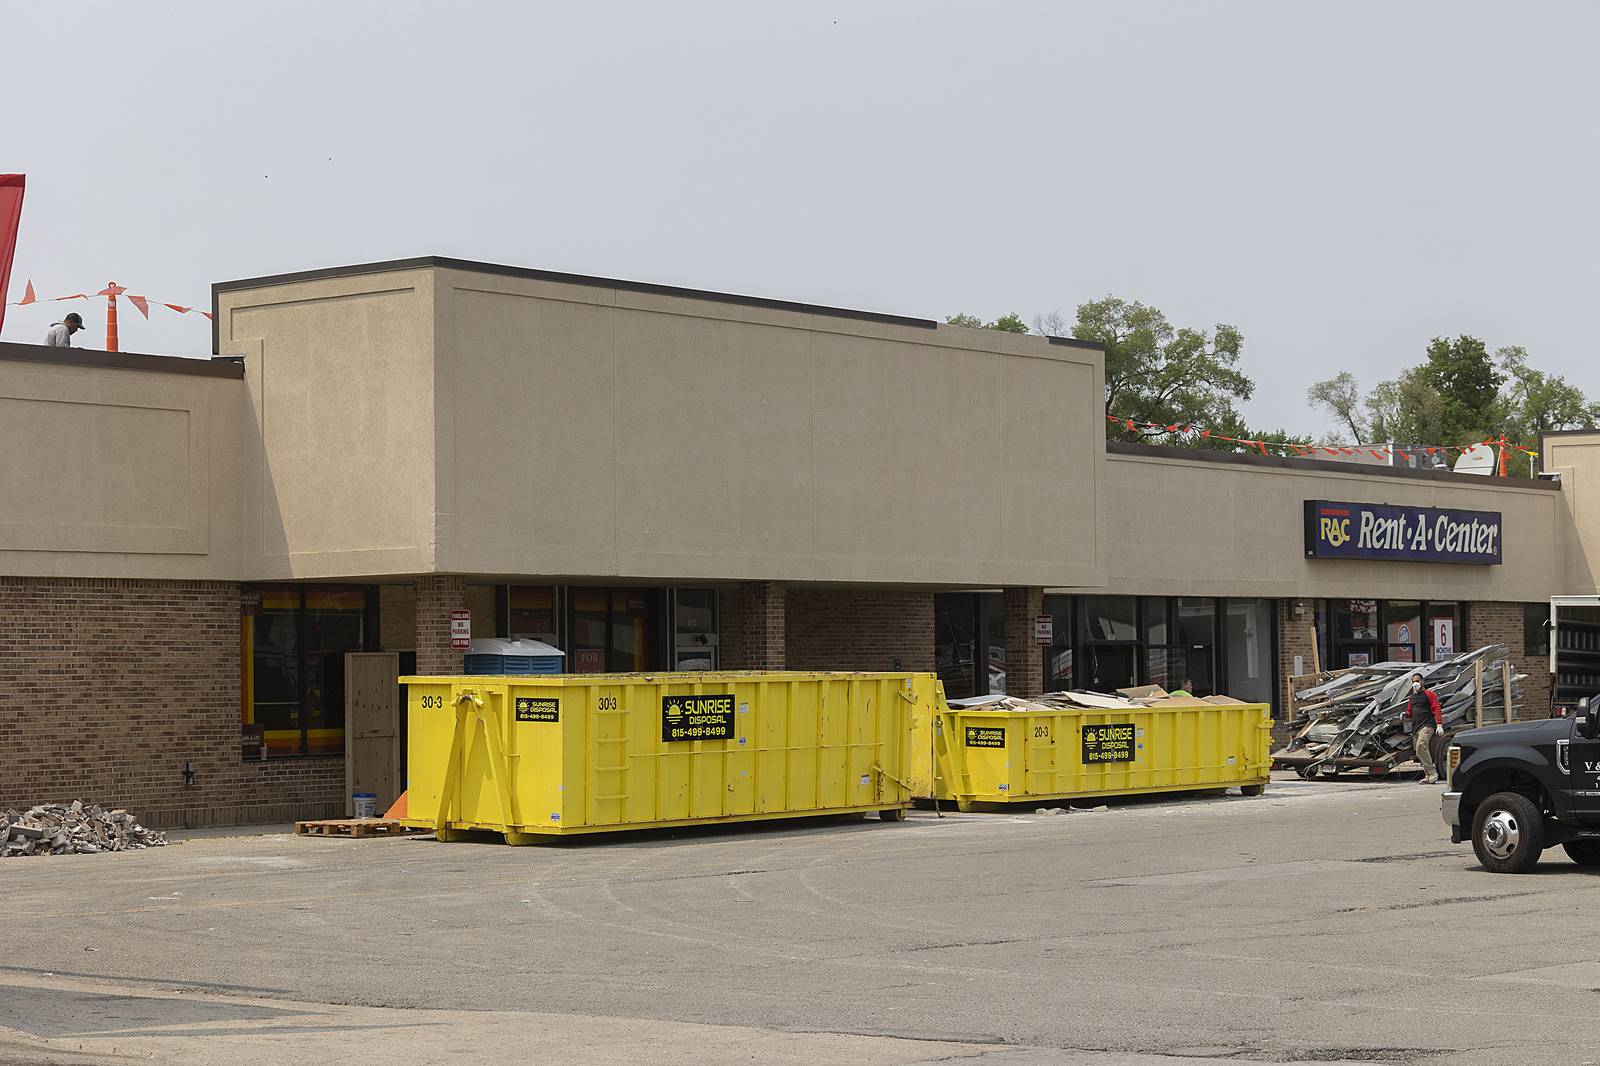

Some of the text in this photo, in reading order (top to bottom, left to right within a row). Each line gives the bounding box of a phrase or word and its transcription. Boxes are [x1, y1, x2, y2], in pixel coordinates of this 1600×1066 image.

[1320, 517, 1351, 547] RAC
[1440, 623, 1447, 647] 6
[1436, 646, 1452, 654] MONTHS
[581, 653, 598, 664] FOR
[421, 695, 443, 709] 30-3
[598, 696, 617, 711] 30-3
[684, 699, 731, 715] SUNRISE
[689, 715, 727, 725] DISPOSAL
[1034, 725, 1049, 739] 20-3
[1098, 727, 1132, 741] SUNRISE
[1102, 741, 1130, 750] DISPOSAL
